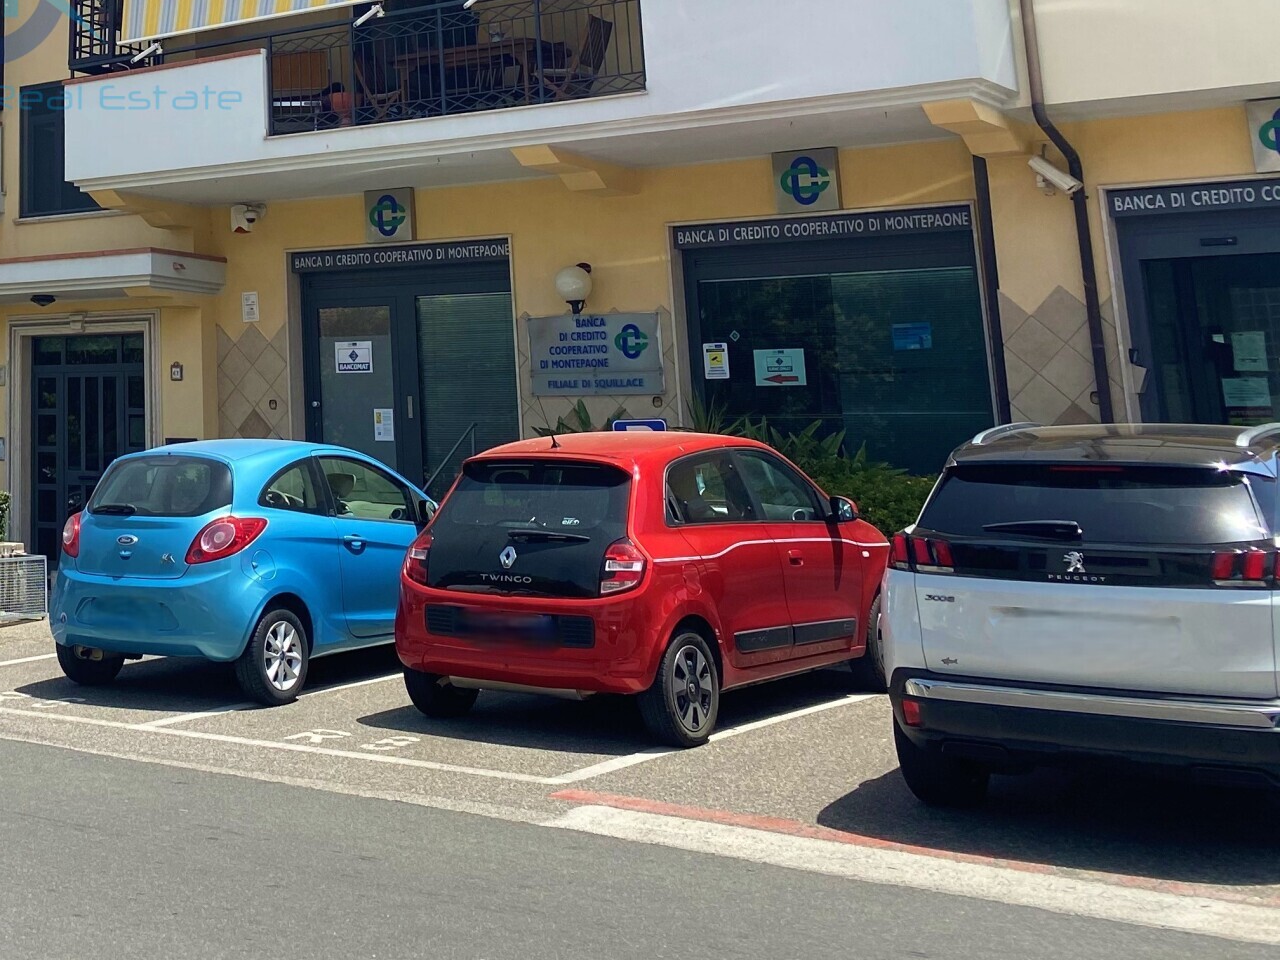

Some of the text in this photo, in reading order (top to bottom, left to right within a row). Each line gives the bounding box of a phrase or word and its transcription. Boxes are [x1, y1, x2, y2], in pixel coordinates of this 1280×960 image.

[1114, 194, 1166, 211] BANCA
[1171, 192, 1186, 208] DI
[1191, 188, 1256, 206] CREDITO
[677, 211, 969, 245] BANCA DI CREDITO COOPERATIVO DI MONTEPAONE
[295, 244, 510, 269] BANCA DI CREDITO COOPERATIVO DI MONTEPAONE
[576, 318, 606, 328] BANCA
[559, 331, 607, 342] DI CREDITO
[549, 344, 608, 356] COOPERATIVO
[339, 363, 370, 371] BANCOMAT
[540, 358, 609, 369] DI MONTEPAONE
[548, 378, 644, 389] FILIALE DI SQUILLACE
[480, 573, 532, 584] TWINGO
[1048, 574, 1107, 582] PEUGEOT
[925, 594, 956, 603] 3008
